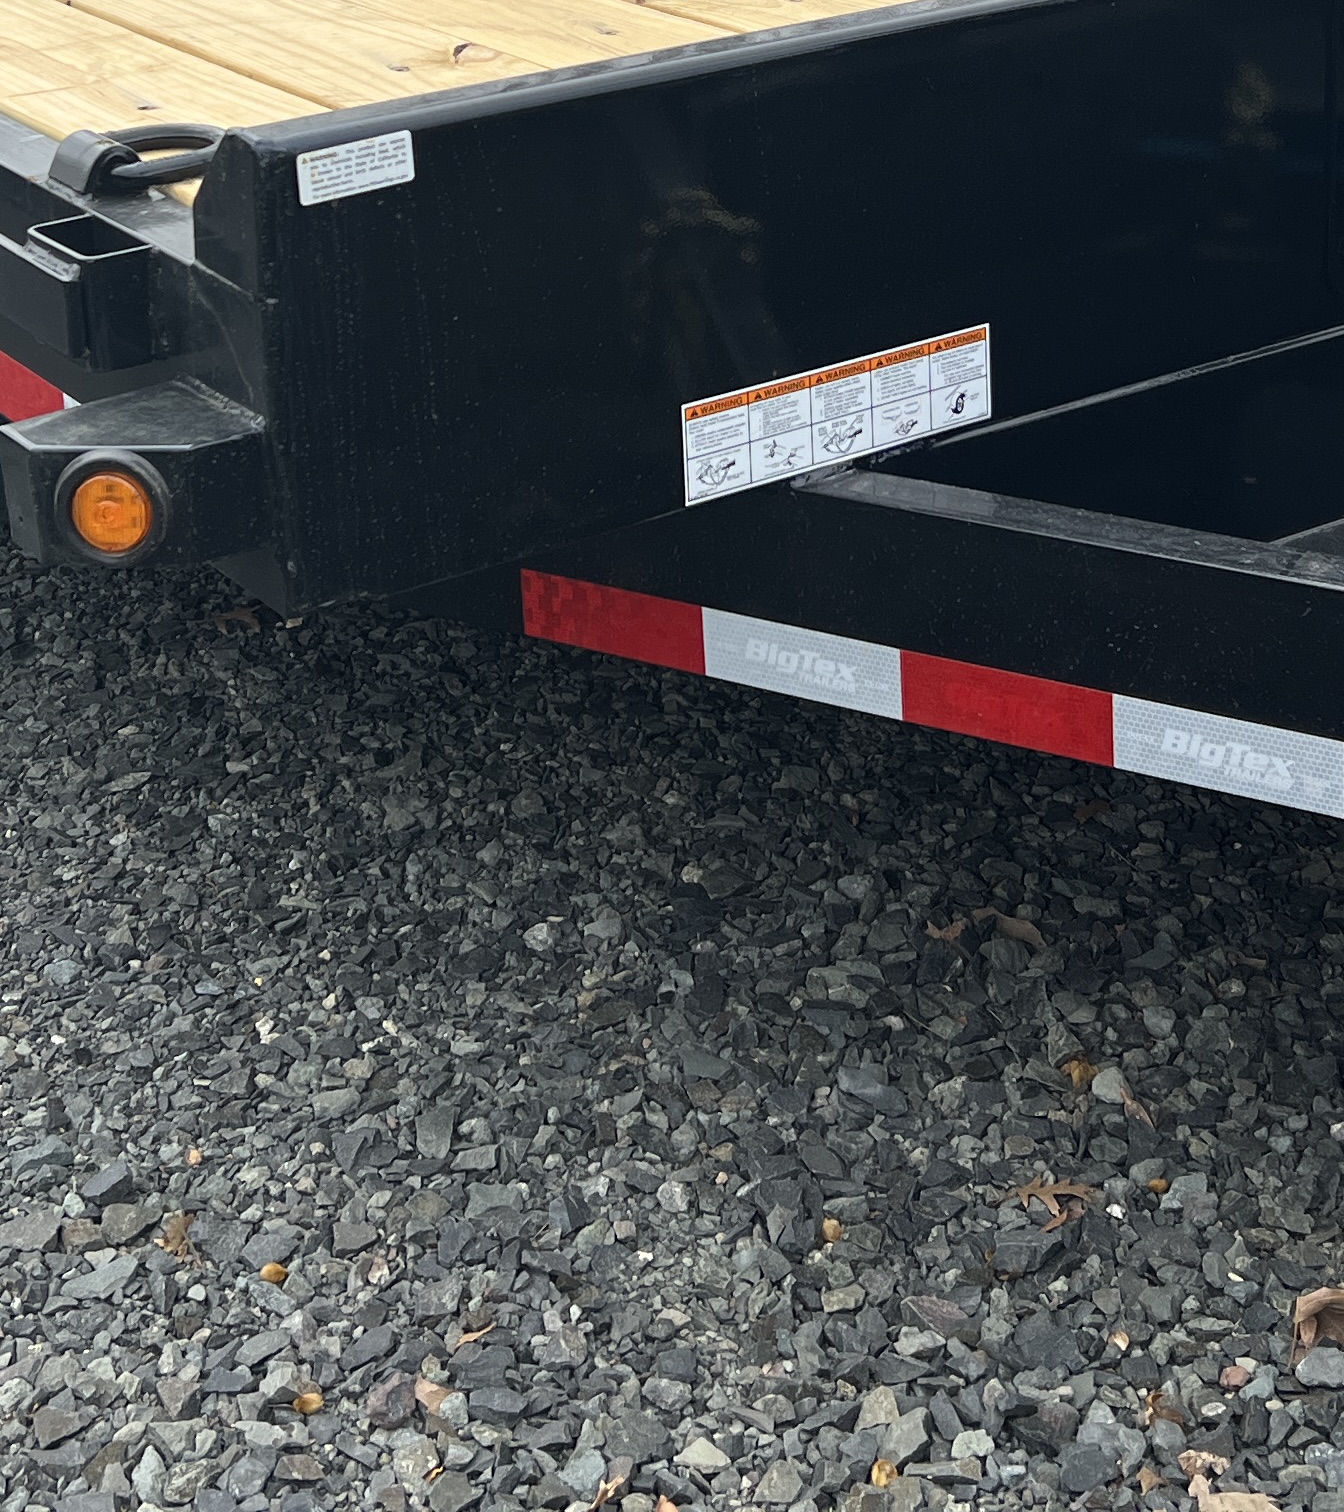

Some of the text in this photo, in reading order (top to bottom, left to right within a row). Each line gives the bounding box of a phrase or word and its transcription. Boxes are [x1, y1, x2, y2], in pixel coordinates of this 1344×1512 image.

[942, 332, 983, 349] WARNING
[884, 347, 926, 365] WARNING
[824, 363, 866, 381] WARNING
[763, 379, 806, 398] WARNING
[699, 396, 744, 415] WARNING
[745, 639, 857, 683] BigTex
[1160, 728, 1295, 779] BigTex
